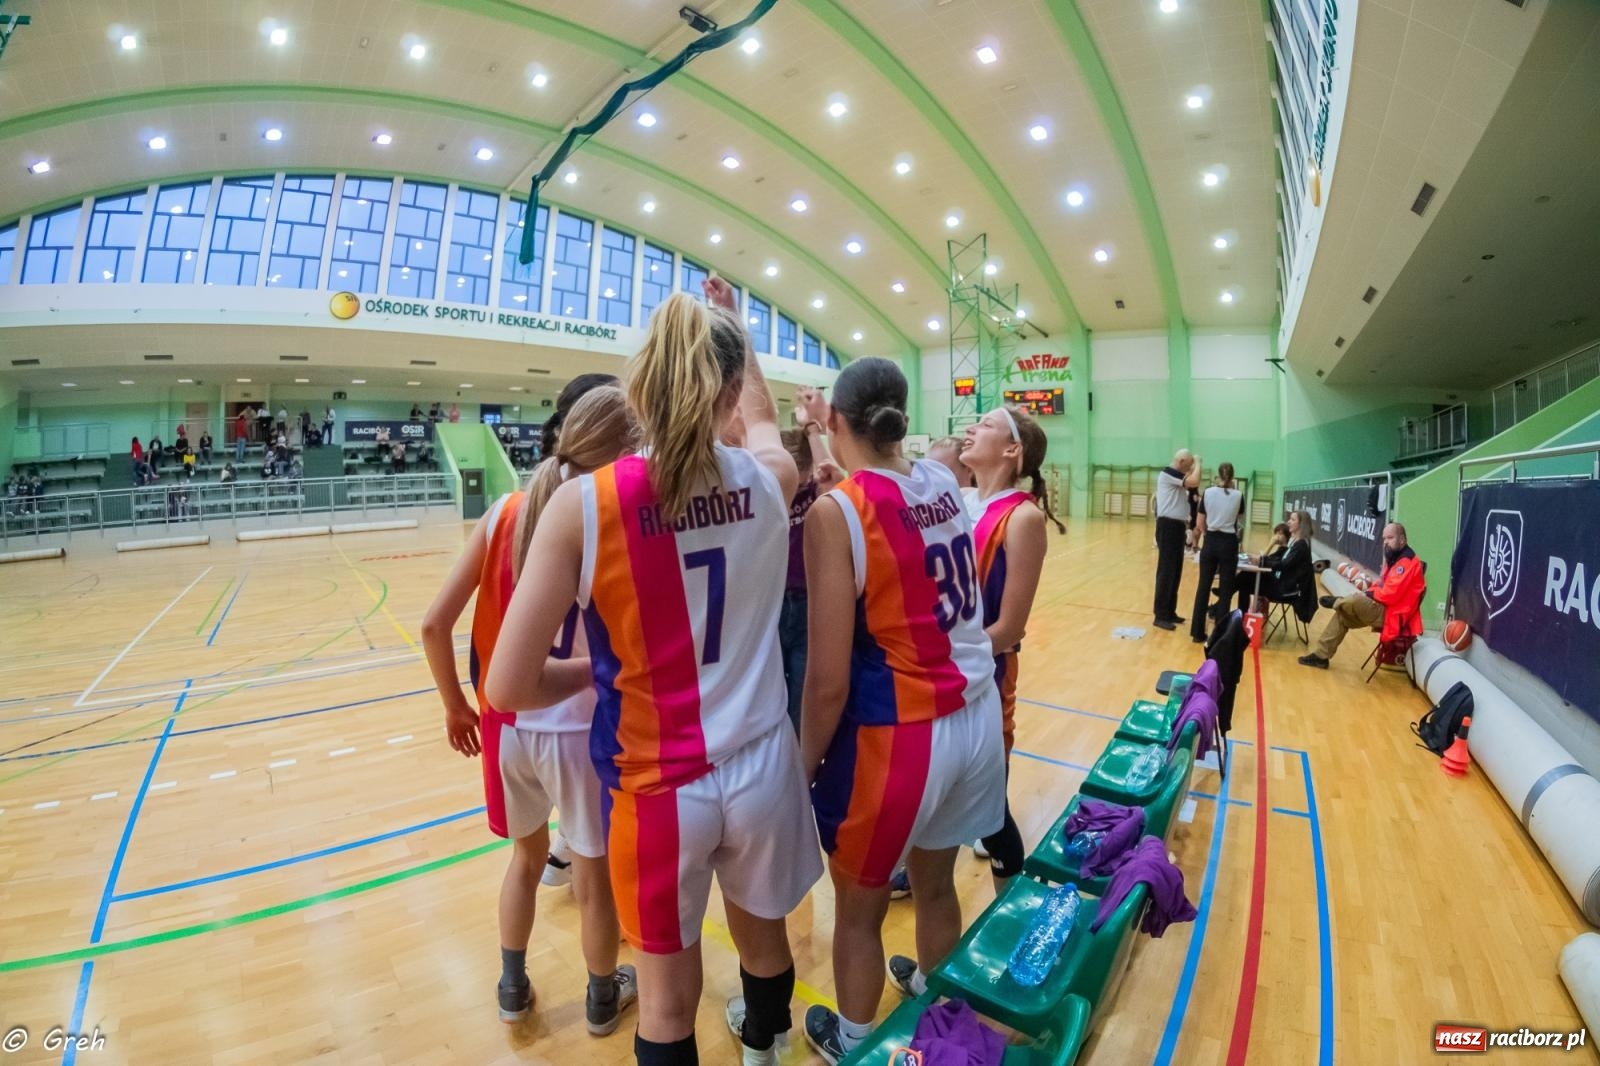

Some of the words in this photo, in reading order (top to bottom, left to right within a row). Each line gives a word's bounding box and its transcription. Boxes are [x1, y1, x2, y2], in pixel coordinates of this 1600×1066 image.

[365, 298, 429, 317] OŚRODEK
[435, 306, 486, 322] SPORTU
[490, 312, 494, 324] I
[498, 313, 560, 332] REKREACJI
[565, 323, 617, 340] RACIBÓRZ
[353, 426, 391, 435] RACIBÓZ
[898, 491, 961, 533] RACIBRZ
[925, 532, 977, 634] 30
[683, 546, 726, 666] 7
[1246, 618, 1256, 638] 5
